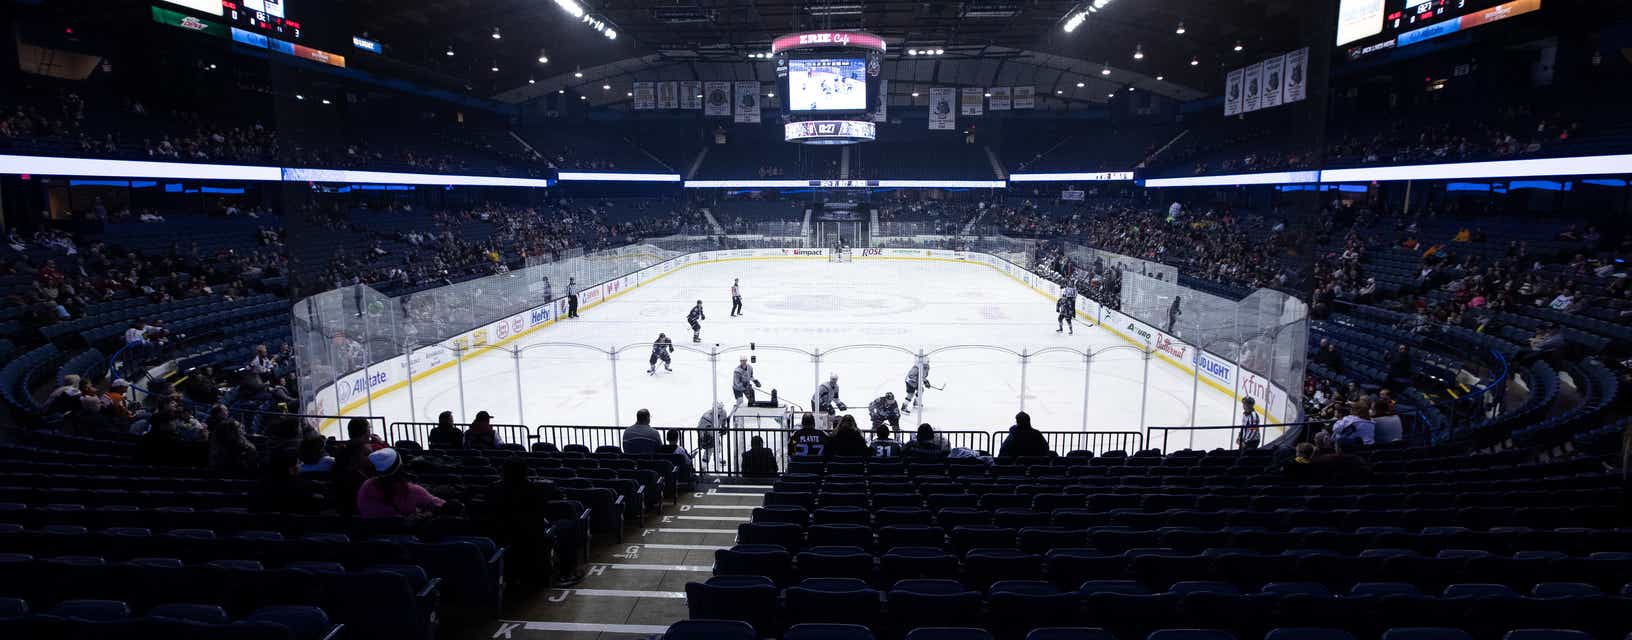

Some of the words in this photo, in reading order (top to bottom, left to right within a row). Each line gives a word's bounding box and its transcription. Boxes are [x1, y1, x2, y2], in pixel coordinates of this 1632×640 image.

[800, 33, 831, 44] ERIE
[531, 308, 550, 324] Hefty
[1207, 360, 1229, 380] LIGHT
[352, 371, 387, 396] Alltate
[875, 445, 891, 457] 31
[680, 504, 692, 512] D
[662, 515, 676, 523] E
[642, 529, 655, 537] F
[625, 545, 640, 554] G
[587, 565, 607, 576] H
[548, 590, 570, 602] J
[492, 623, 522, 639] K
